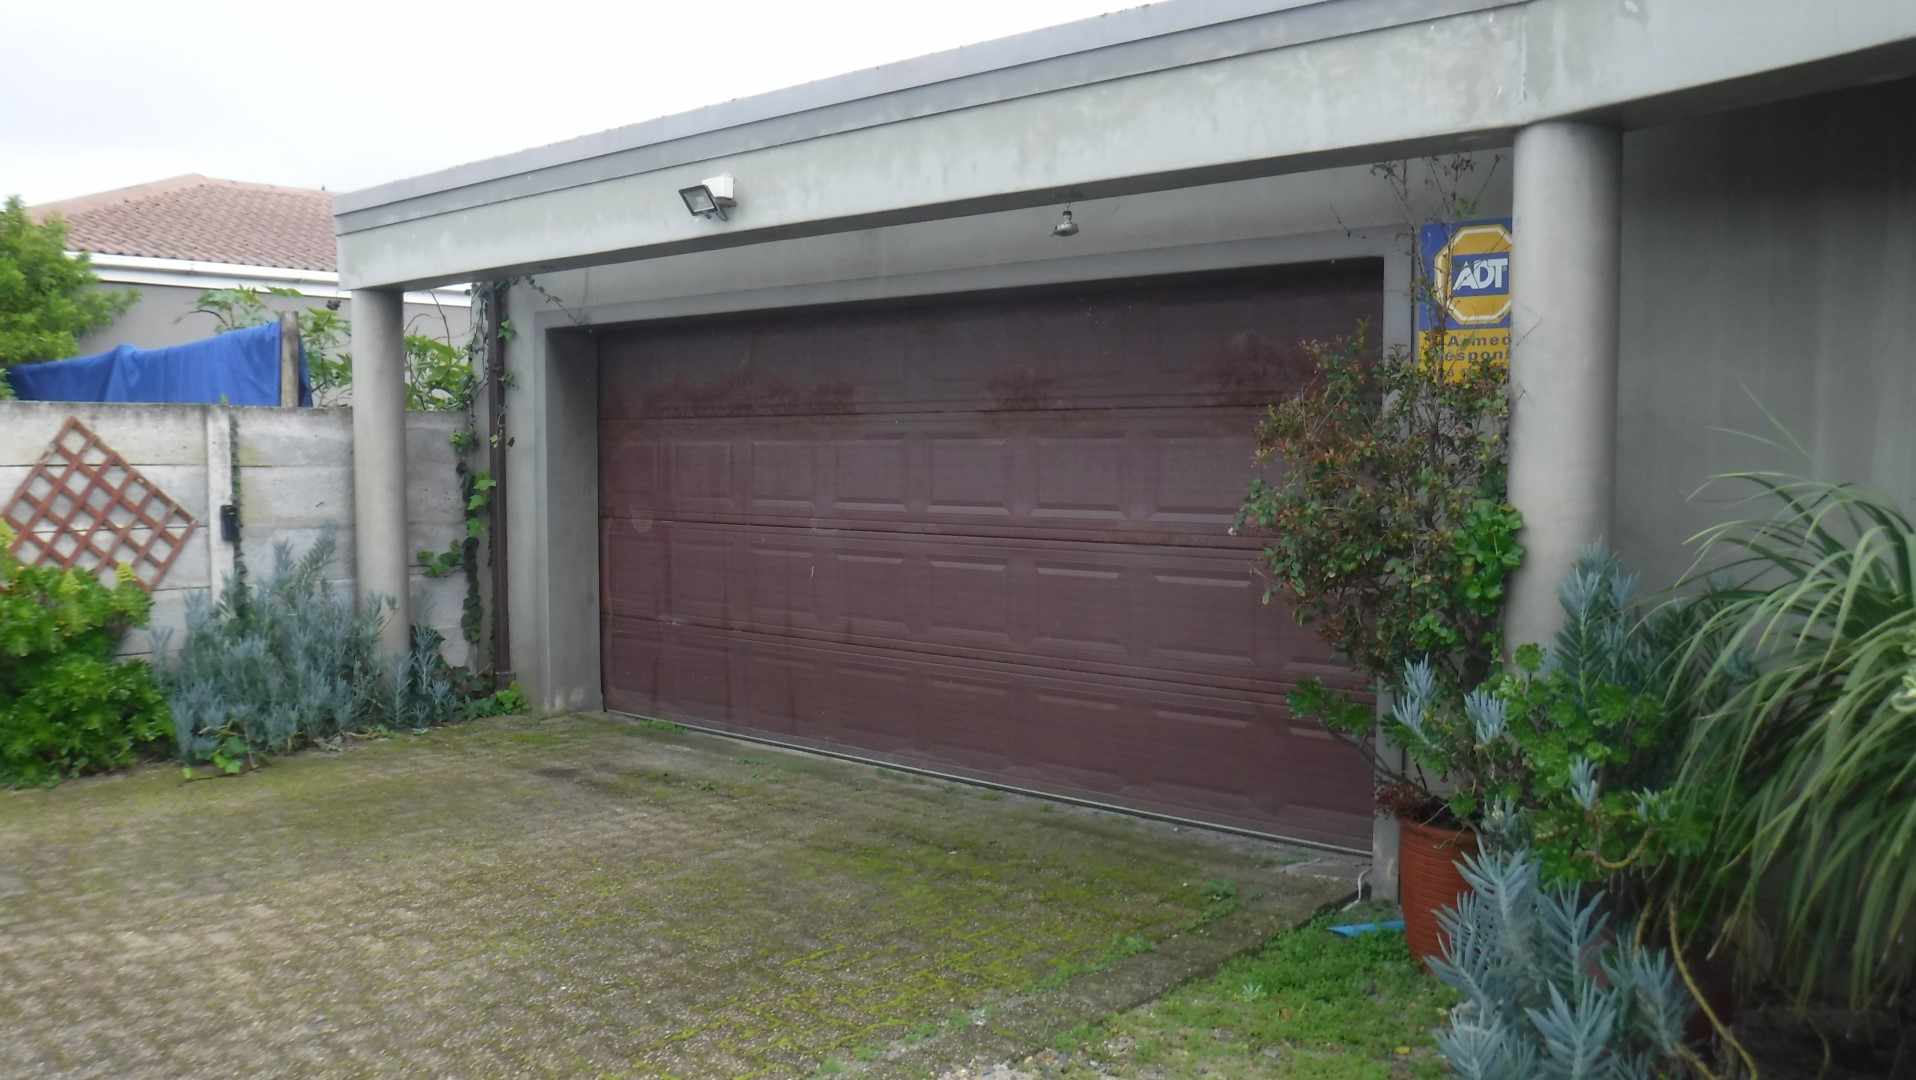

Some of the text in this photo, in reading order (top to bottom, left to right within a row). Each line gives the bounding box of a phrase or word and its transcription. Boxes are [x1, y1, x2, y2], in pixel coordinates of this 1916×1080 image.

[1453, 257, 1508, 290] ADT
[1448, 335, 1512, 347] Amed
[1436, 349, 1506, 362] espon
